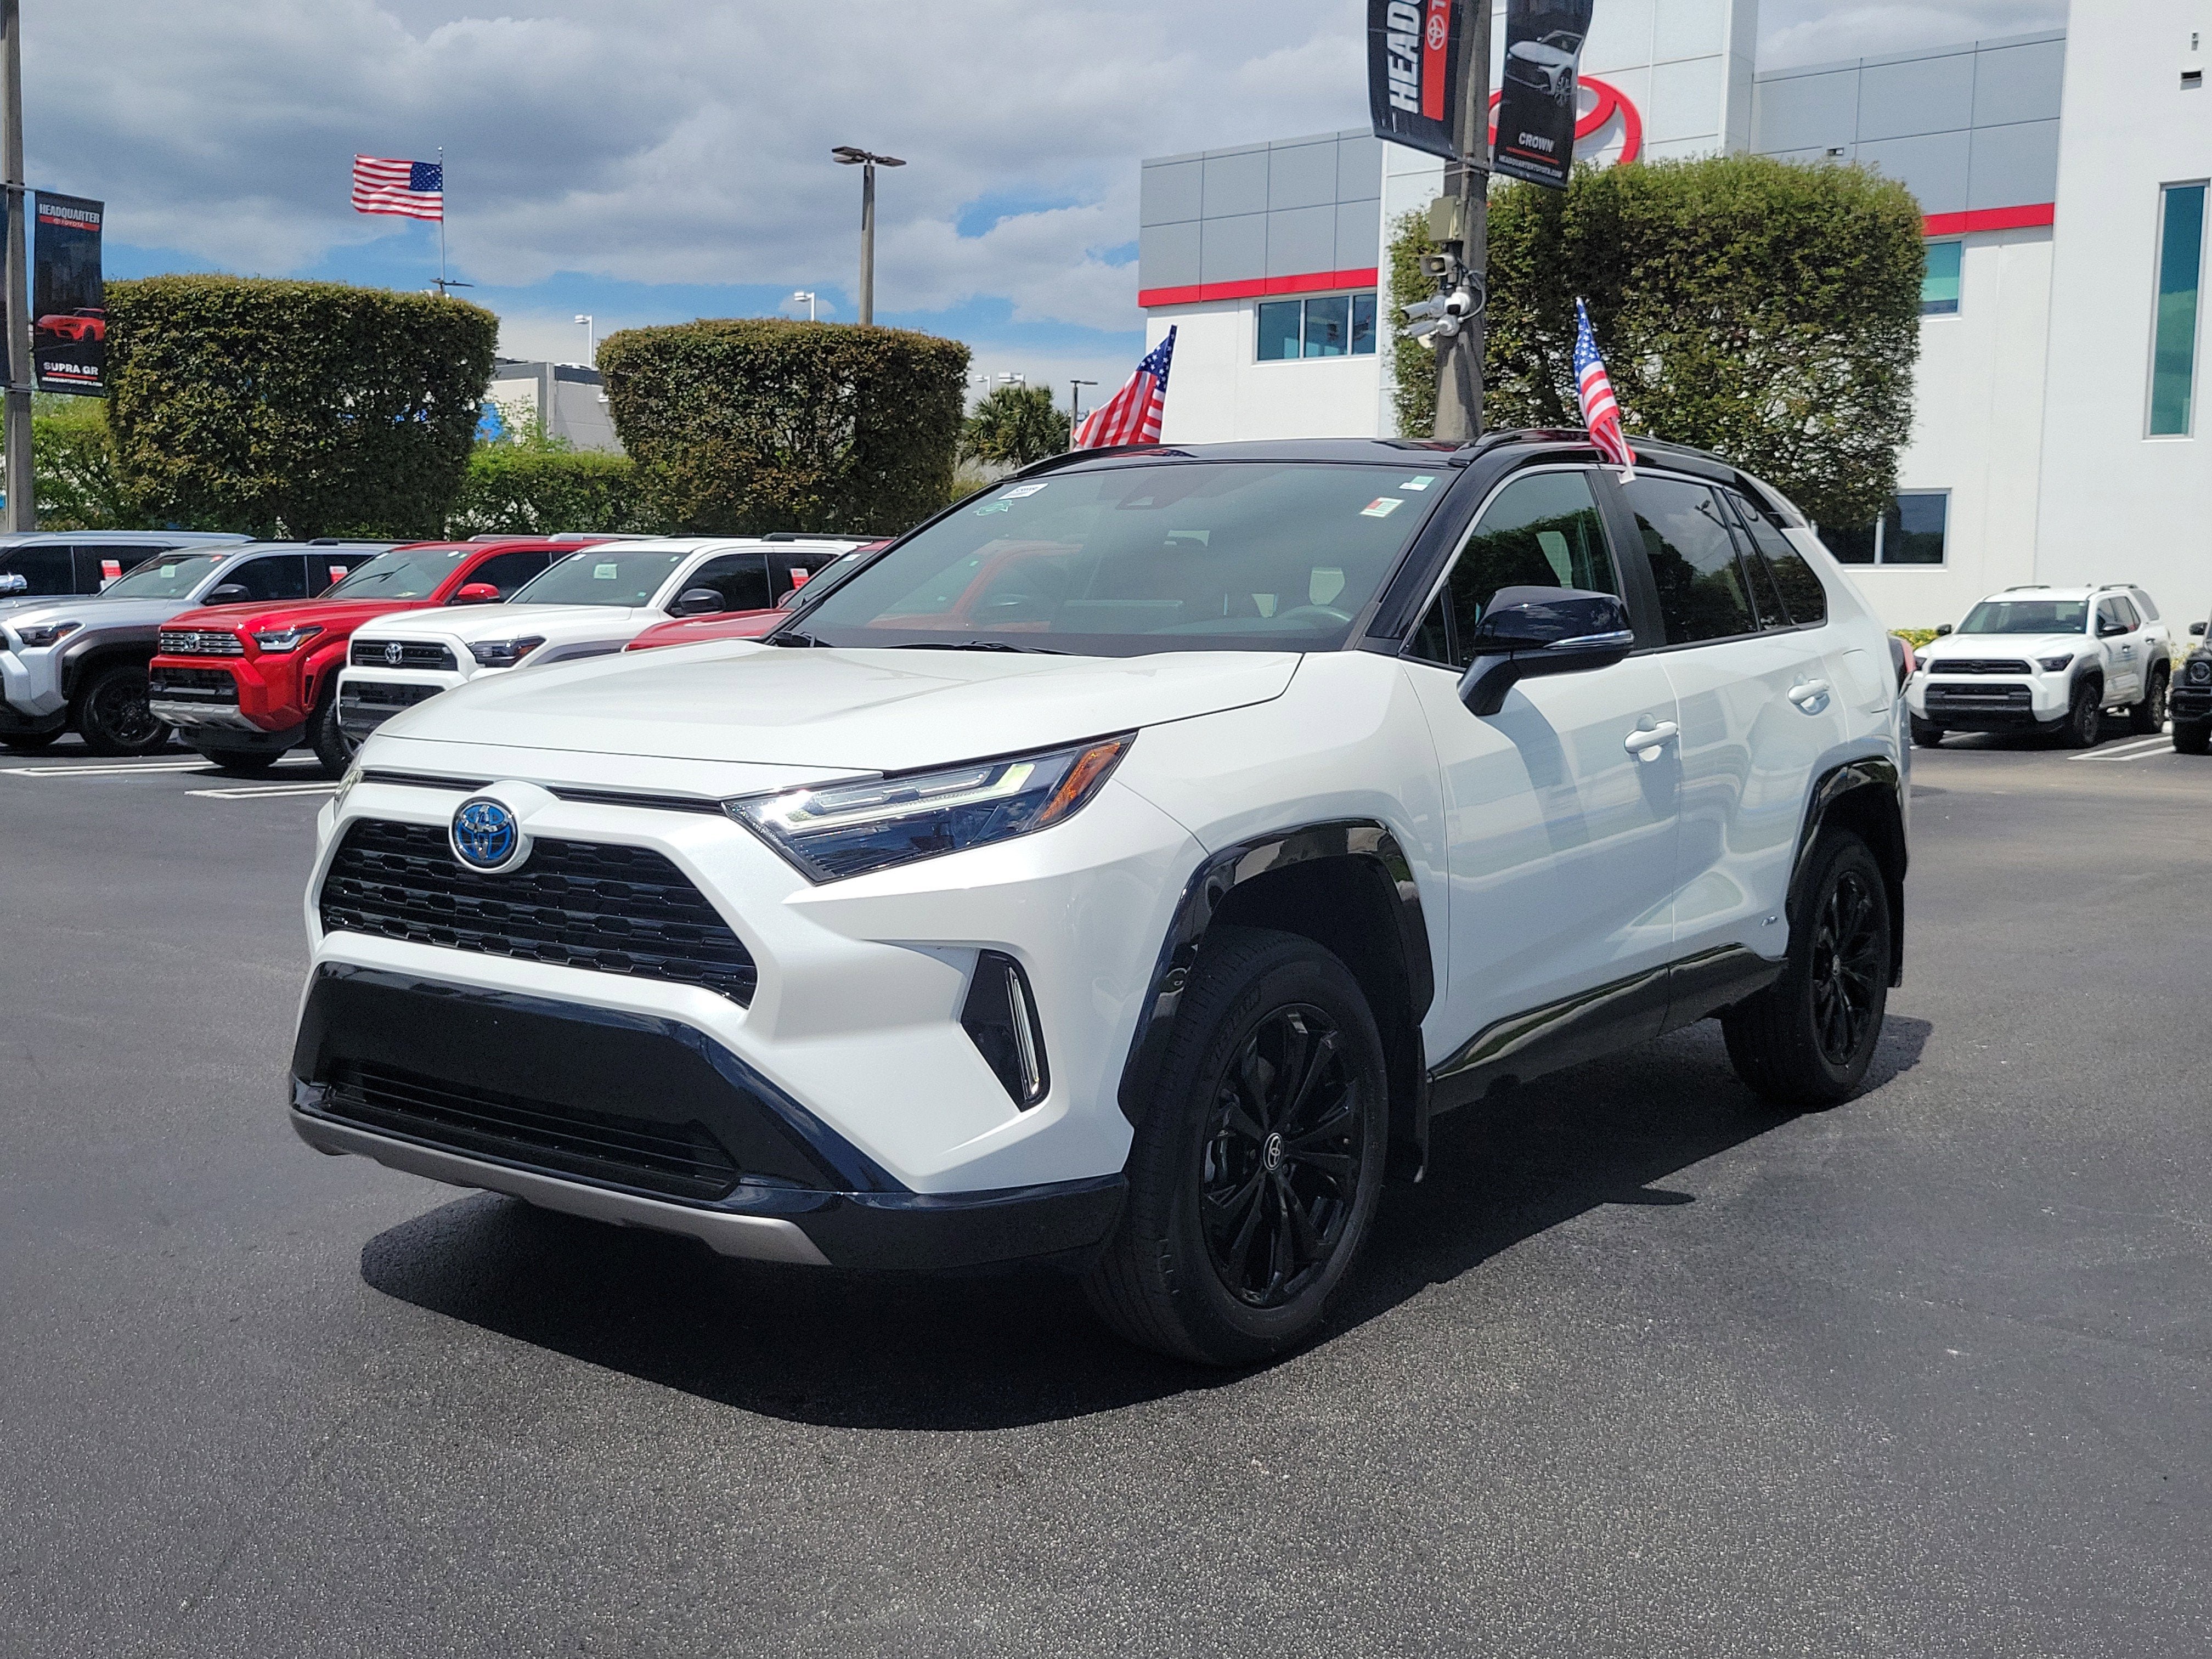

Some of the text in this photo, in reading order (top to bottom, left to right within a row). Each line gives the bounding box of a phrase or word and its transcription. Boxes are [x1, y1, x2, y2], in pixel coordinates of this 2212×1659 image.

[1387, 0, 1421, 114] HEAD
[1518, 131, 1555, 153] CROWN
[40, 204, 100, 223] HEADQUARTER
[43, 362, 99, 375] SUPRA GR
